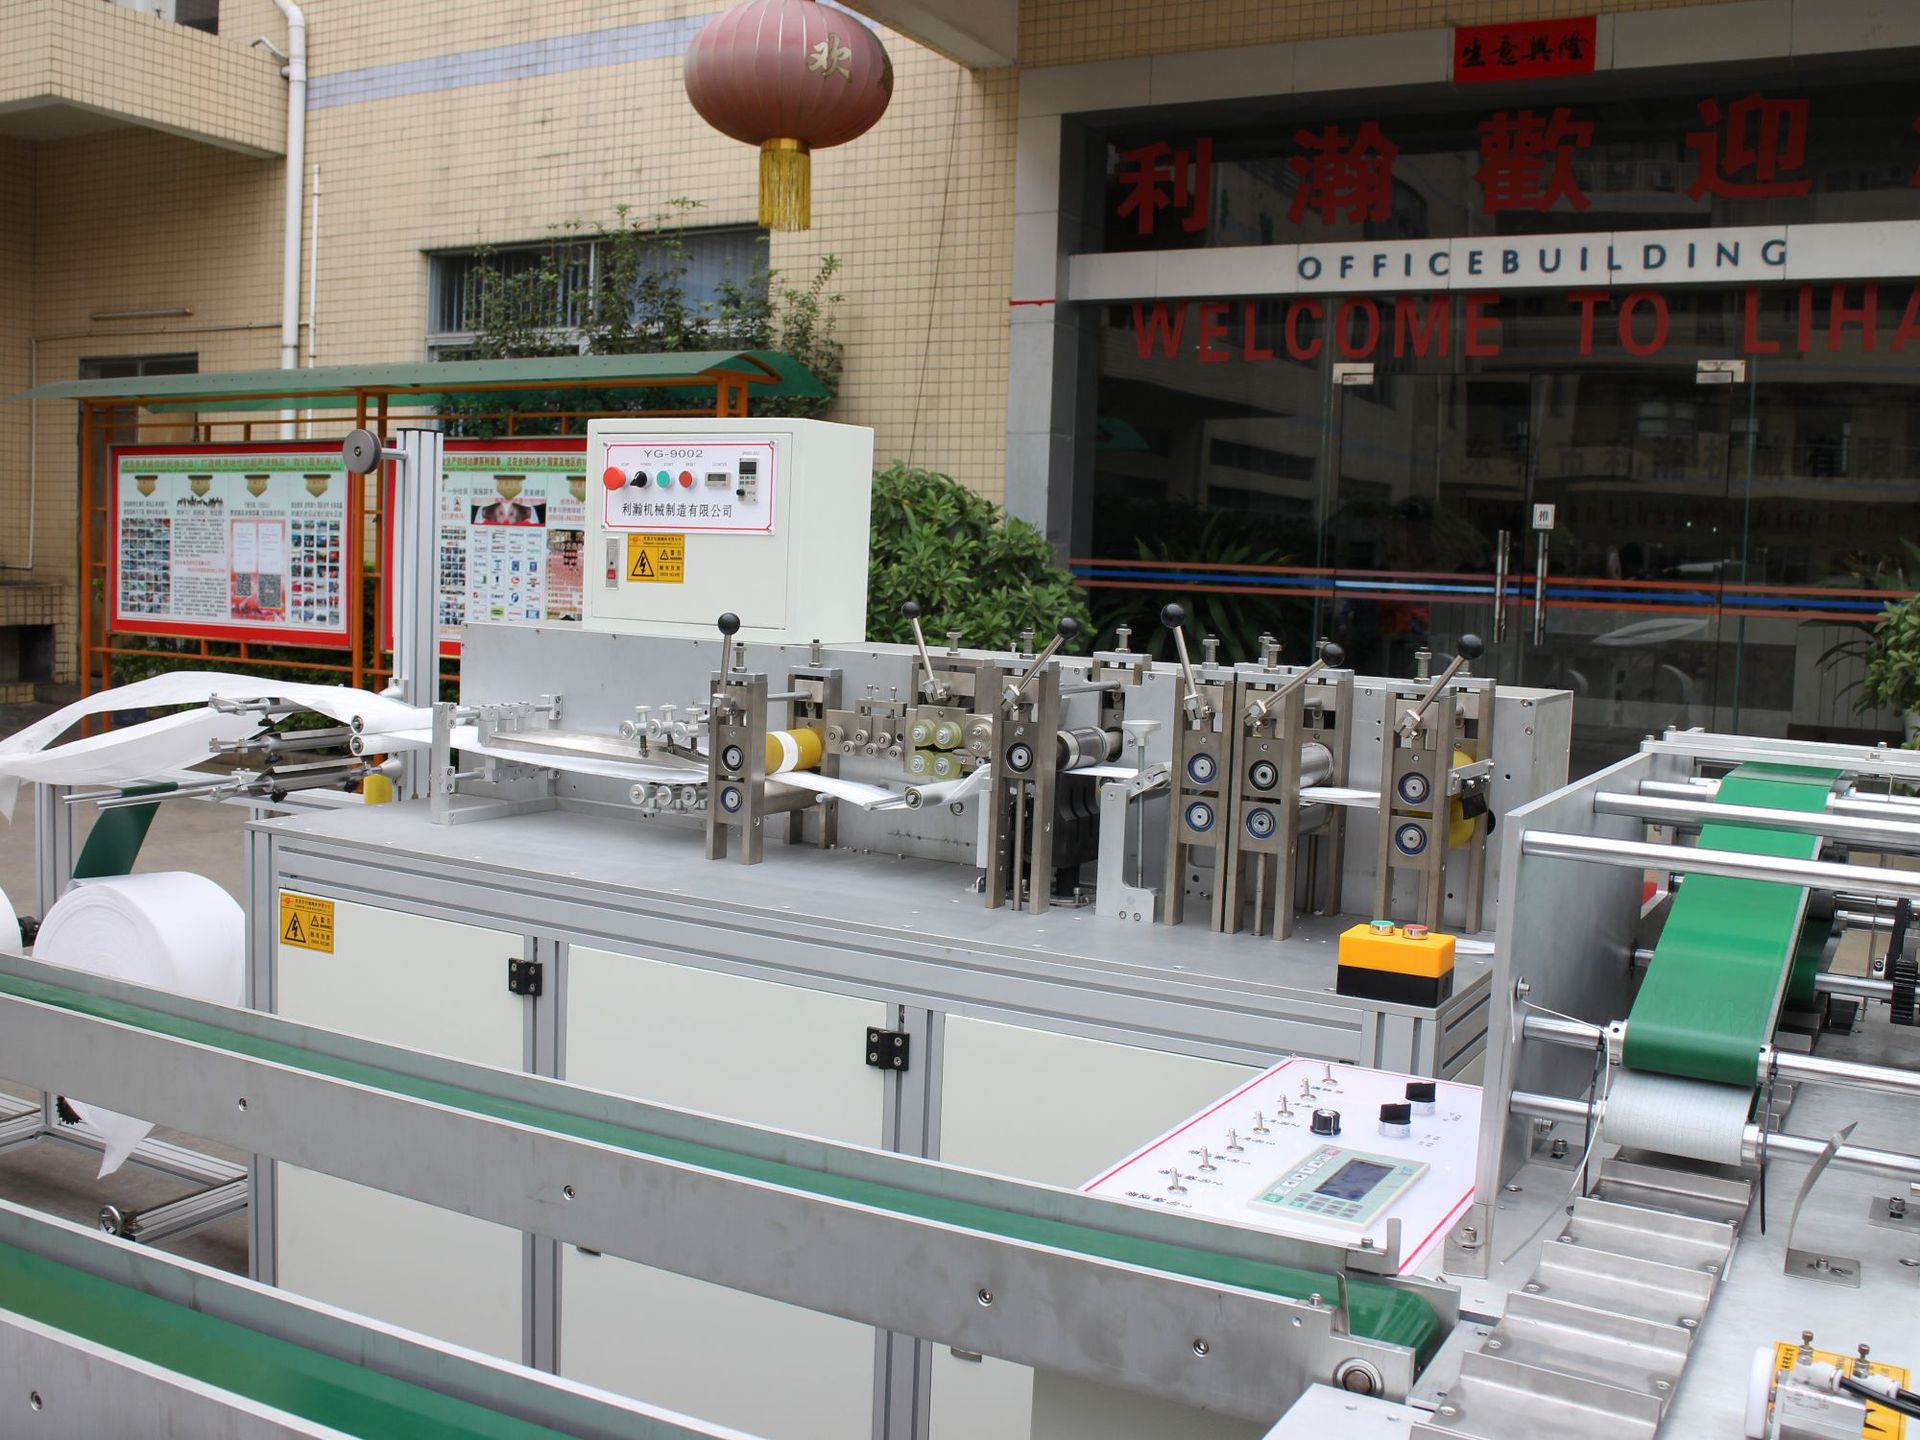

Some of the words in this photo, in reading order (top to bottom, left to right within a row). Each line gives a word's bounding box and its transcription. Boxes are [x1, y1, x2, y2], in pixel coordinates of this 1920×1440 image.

[807, 32, 852, 82] 欢
[1116, 93, 1920, 236] 利瀚歡迎
[1132, 293, 1502, 363] WELCOME
[1567, 288, 1670, 357] TO
[643, 449, 704, 459] YG-9002
[621, 502, 733, 519] 利瀚机械制造有限公司
